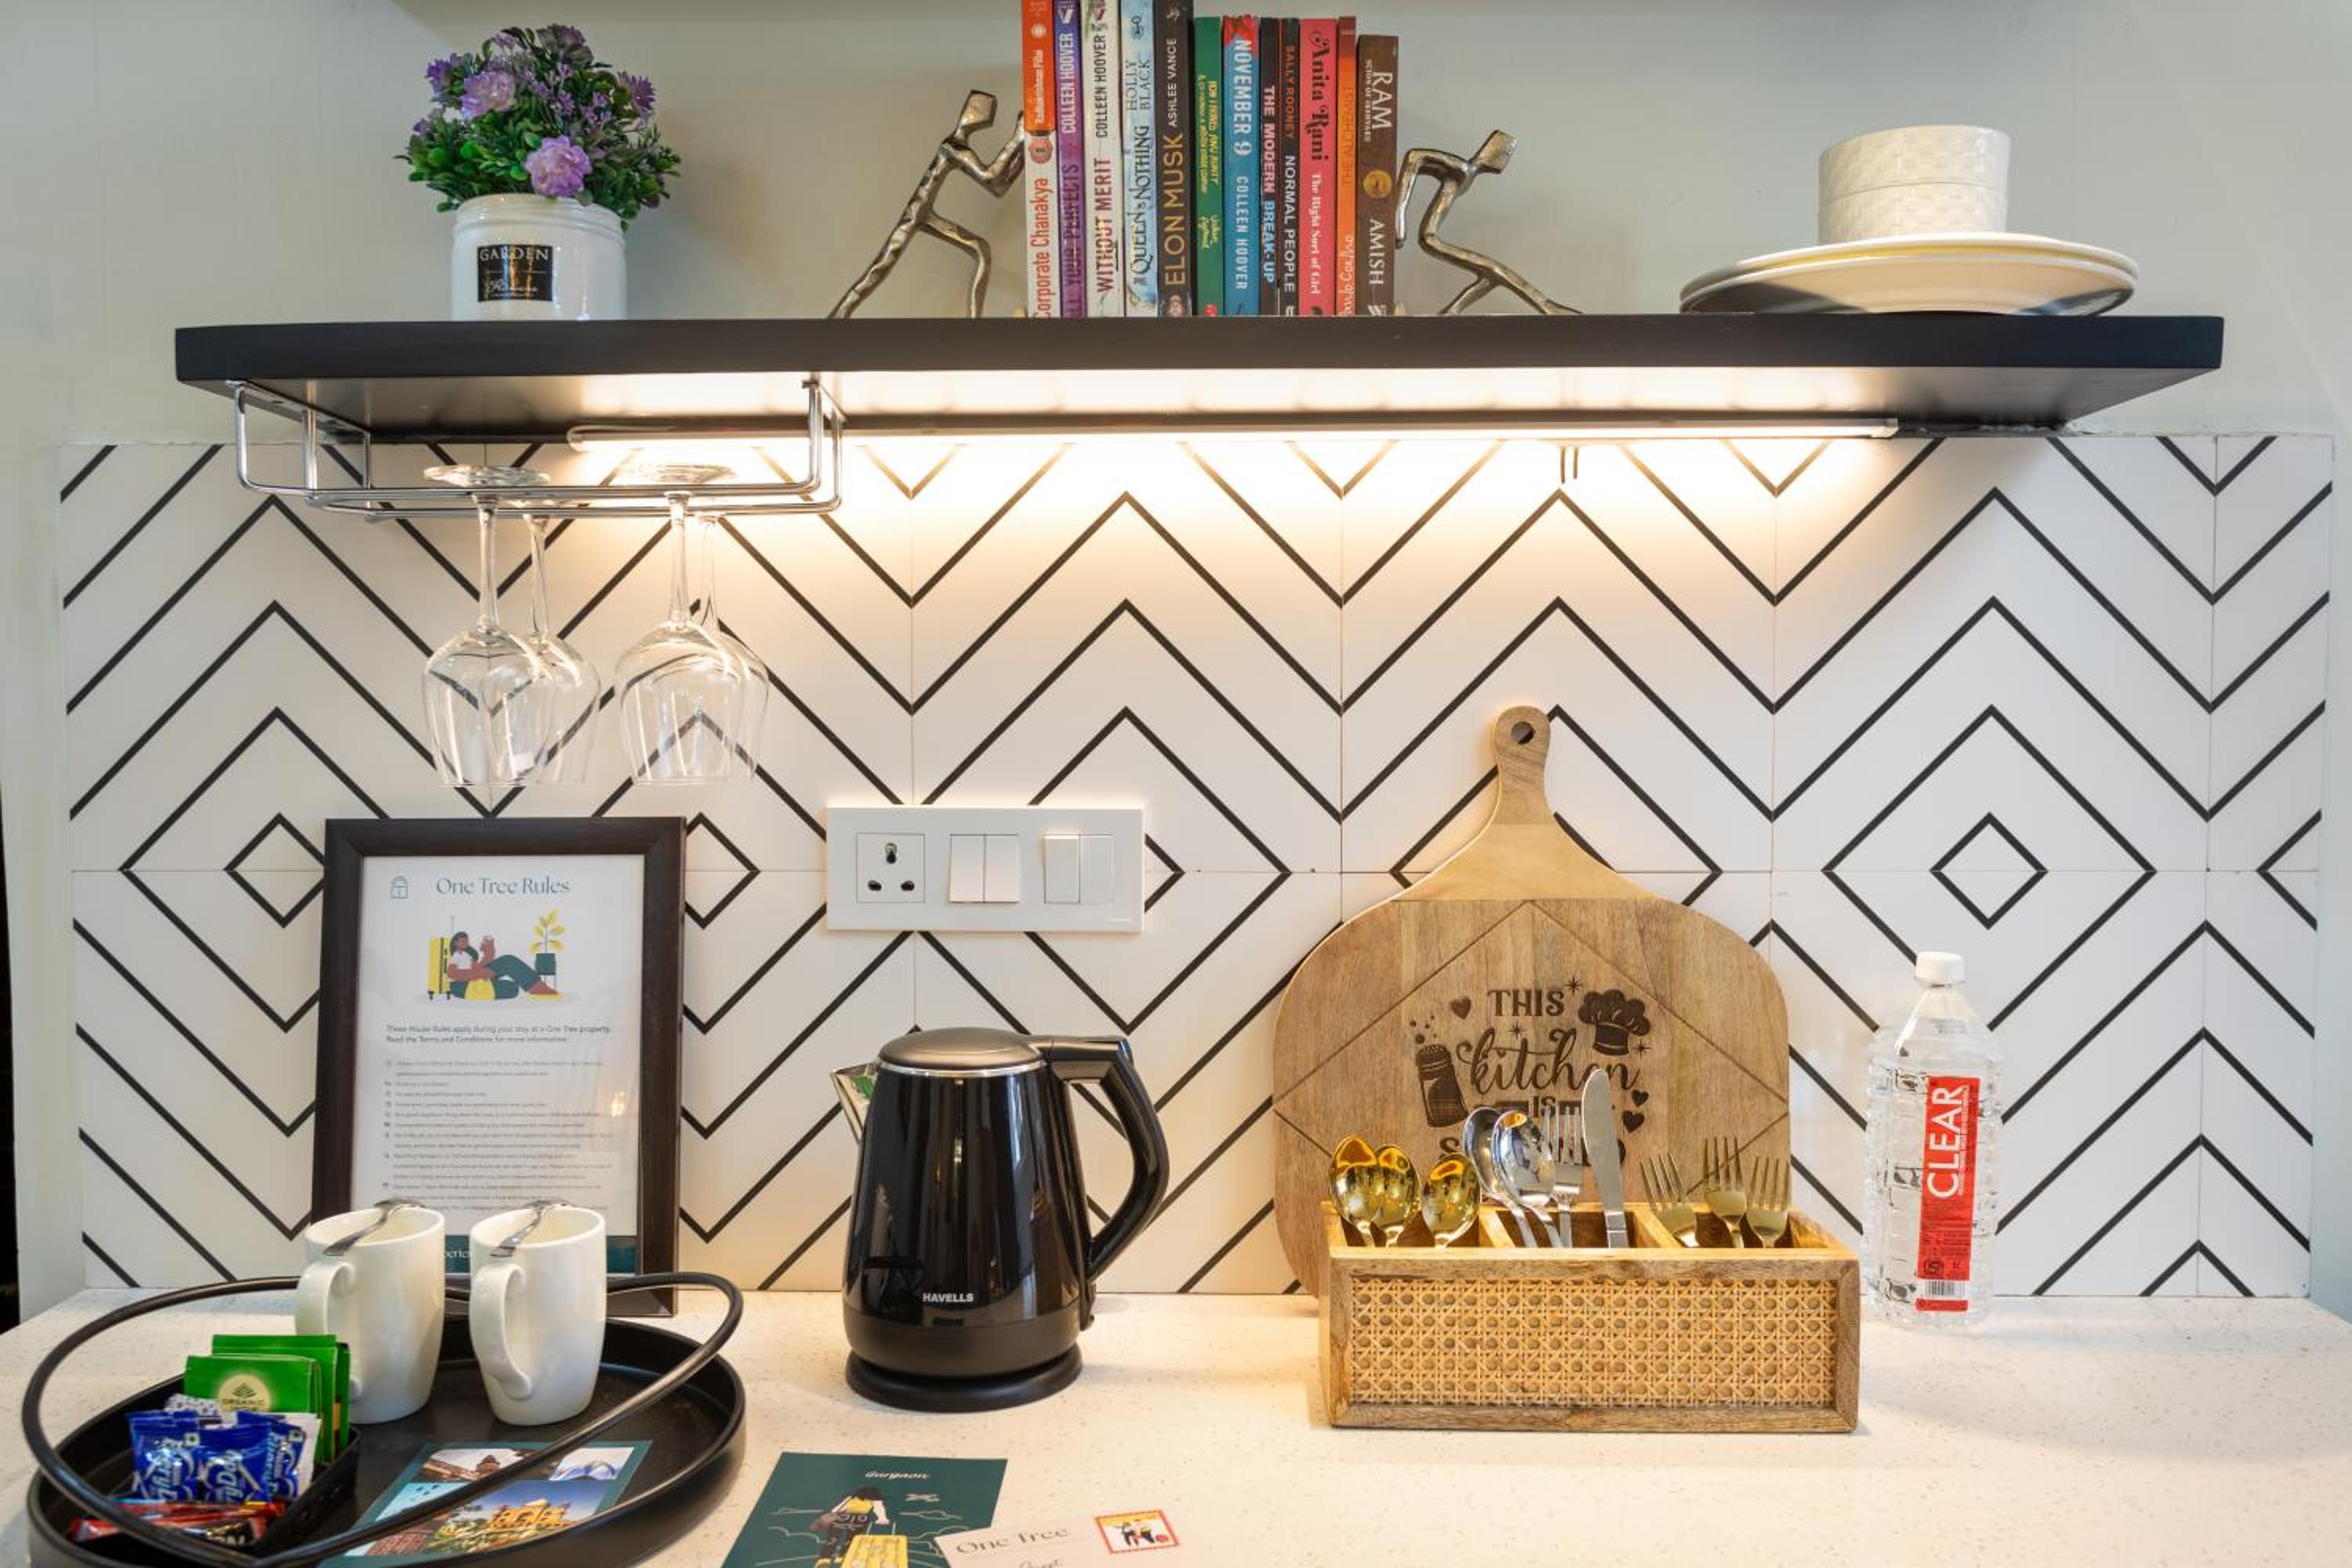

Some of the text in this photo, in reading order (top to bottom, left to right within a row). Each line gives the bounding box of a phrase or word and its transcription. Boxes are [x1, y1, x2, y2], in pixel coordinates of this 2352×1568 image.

[1060, 33, 1076, 133] COLLEEN HOOVER
[1093, 34, 1108, 138] COLLEEN HOOVER
[1126, 60, 1137, 111] HOLLY
[1139, 60, 1150, 111] BLACK
[1167, 38, 1177, 127] ASHLEE VANCE
[1233, 40, 1252, 155] NOVEMBER 9
[1285, 45, 1294, 139] SALLY ROONEY
[1305, 30, 1330, 161] Anita Rani
[1372, 71, 1393, 129] RAM
[1129, 125, 1150, 201] NOTHING
[1263, 85, 1276, 284] THE MODERN BREAK-UP
[1029, 178, 1054, 247] Chanakya
[1094, 158, 1115, 292] WITHOUT MERIT
[1127, 212, 1153, 274] QUEEN
[1163, 133, 1185, 285] ELON MUSK
[1235, 176, 1248, 289] COLLEEN HOOVER
[1284, 155, 1295, 292] NORMAL PEOPLE
[480, 246, 549, 261] GARDEN
[1370, 219, 1385, 285] AMISH
[436, 876, 571, 895] One Tree Rules
[1487, 989, 1565, 1017] THIS
[1456, 1028, 1640, 1095] kitchn
[1532, 1096, 1556, 1118] IS
[1926, 1084, 1964, 1199] CLEAR
[922, 1292, 975, 1303] HAVELLS
[956, 1526, 1069, 1555] One Tree
